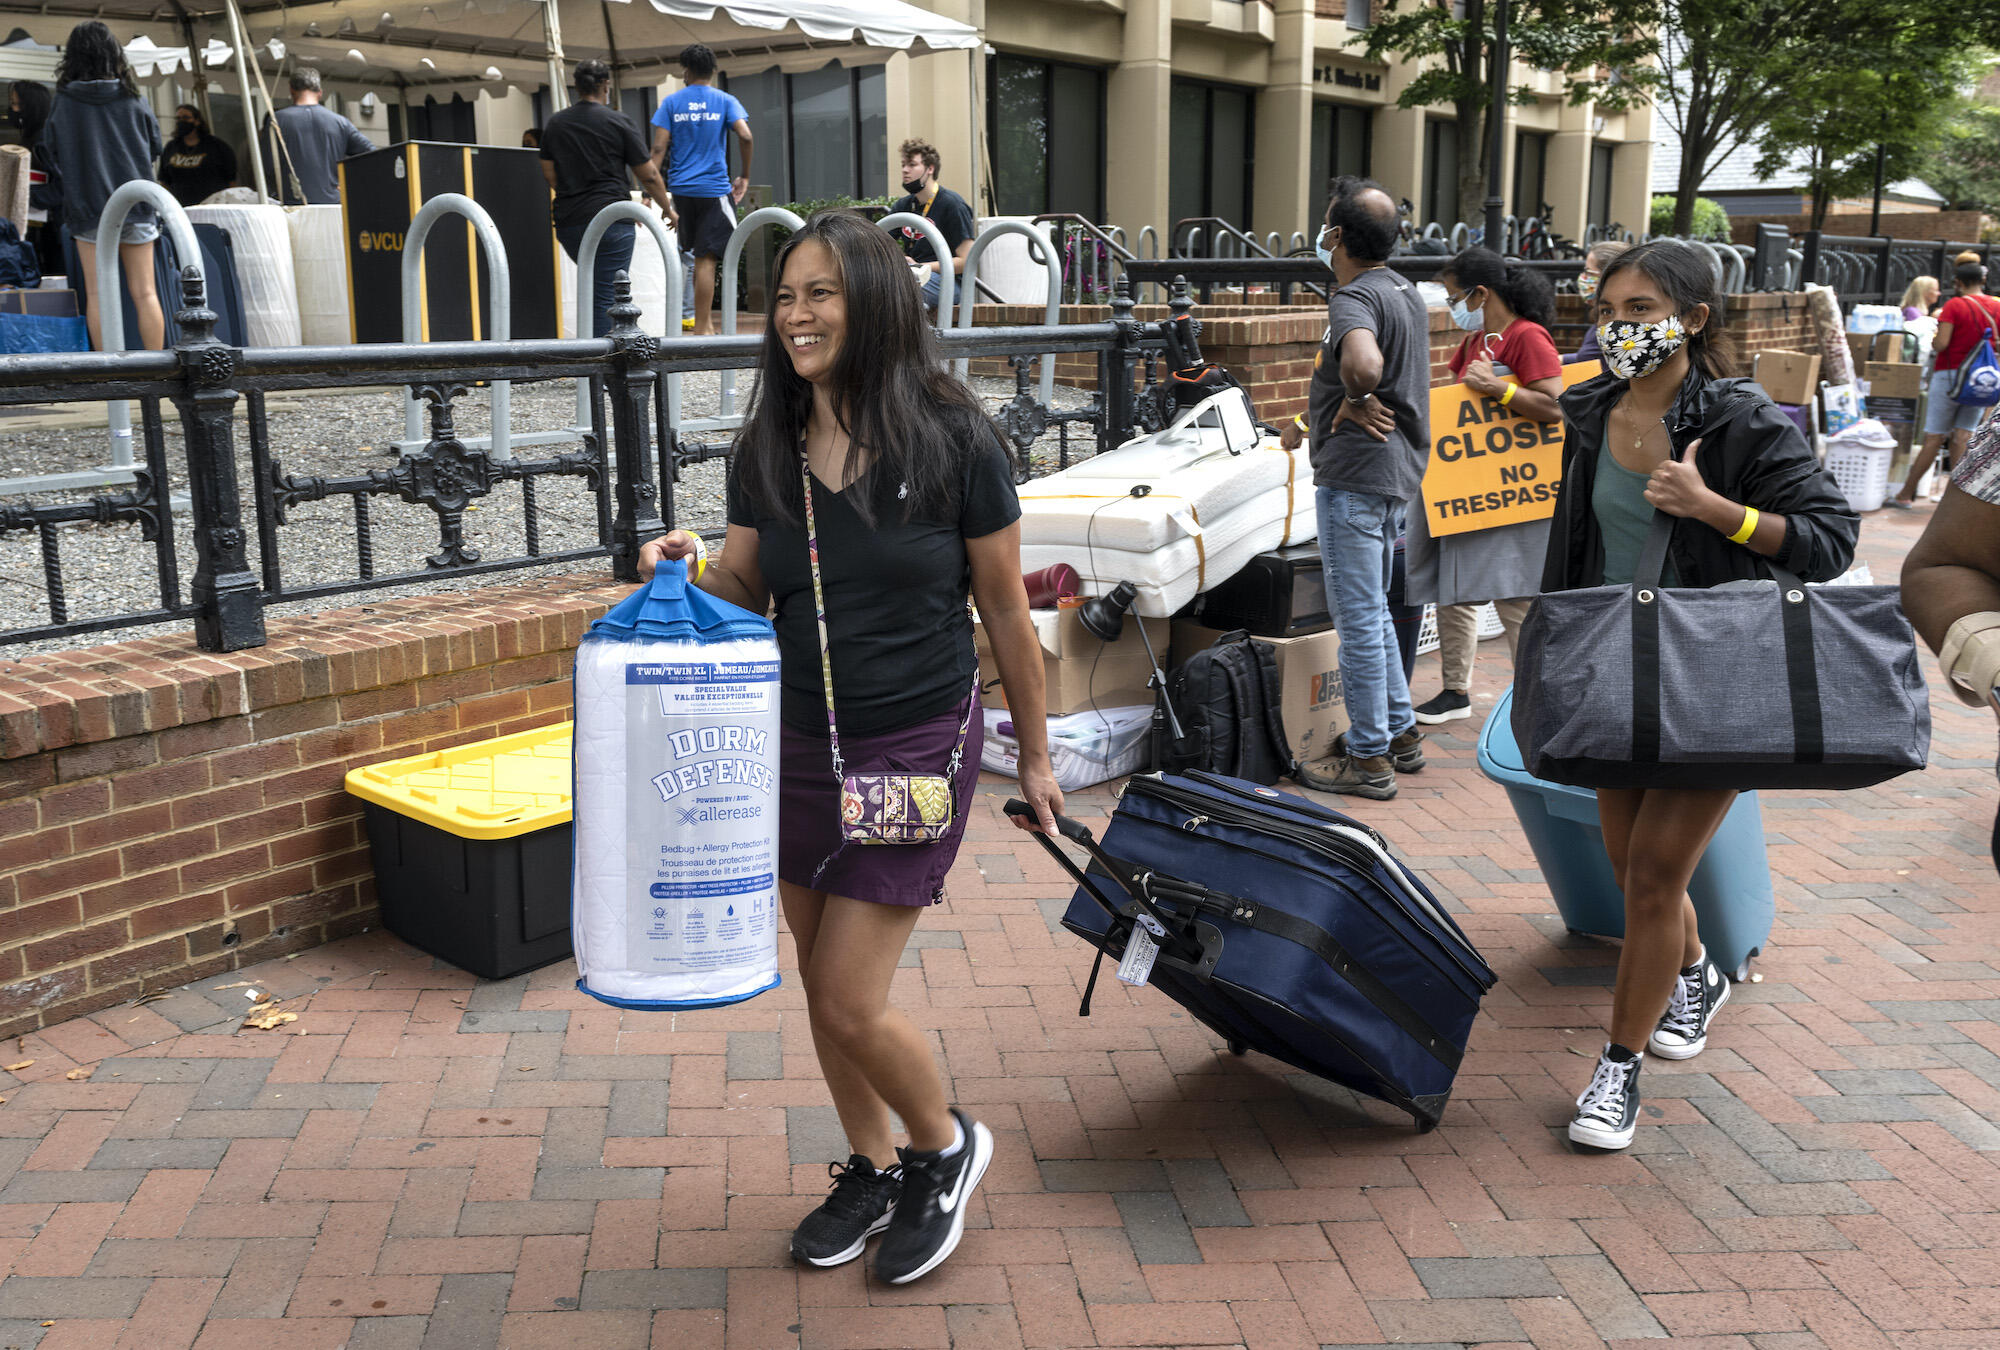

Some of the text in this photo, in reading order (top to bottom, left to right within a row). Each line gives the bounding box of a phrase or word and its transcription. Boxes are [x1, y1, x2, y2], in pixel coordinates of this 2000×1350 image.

[673, 113, 690, 123] DAY
[690, 112, 701, 121] OF
[174, 153, 204, 168] VCU
[371, 232, 403, 251] VCU
[1457, 396, 1524, 428] AR
[1436, 421, 1563, 462] CLOSE
[1500, 463, 1538, 485] NO
[1434, 481, 1561, 519] TRESPASS
[636, 667, 692, 676] TWIN/TWIN
[694, 666, 707, 675] XL
[706, 692, 763, 700] EXCEPTIONNELLE
[667, 725, 767, 761] DORM
[651, 759, 775, 802] DEFENSE
[699, 806, 761, 822] allerease
[661, 845, 694, 854] Bedbug
[702, 843, 729, 852] Allergy
[732, 839, 762, 849] Protection
[661, 859, 704, 867] Trousseau
[719, 854, 753, 864] protection
[672, 869, 709, 879] punaises
[711, 867, 721, 875] de
[732, 865, 739, 873] et
[741, 864, 751, 872] les
